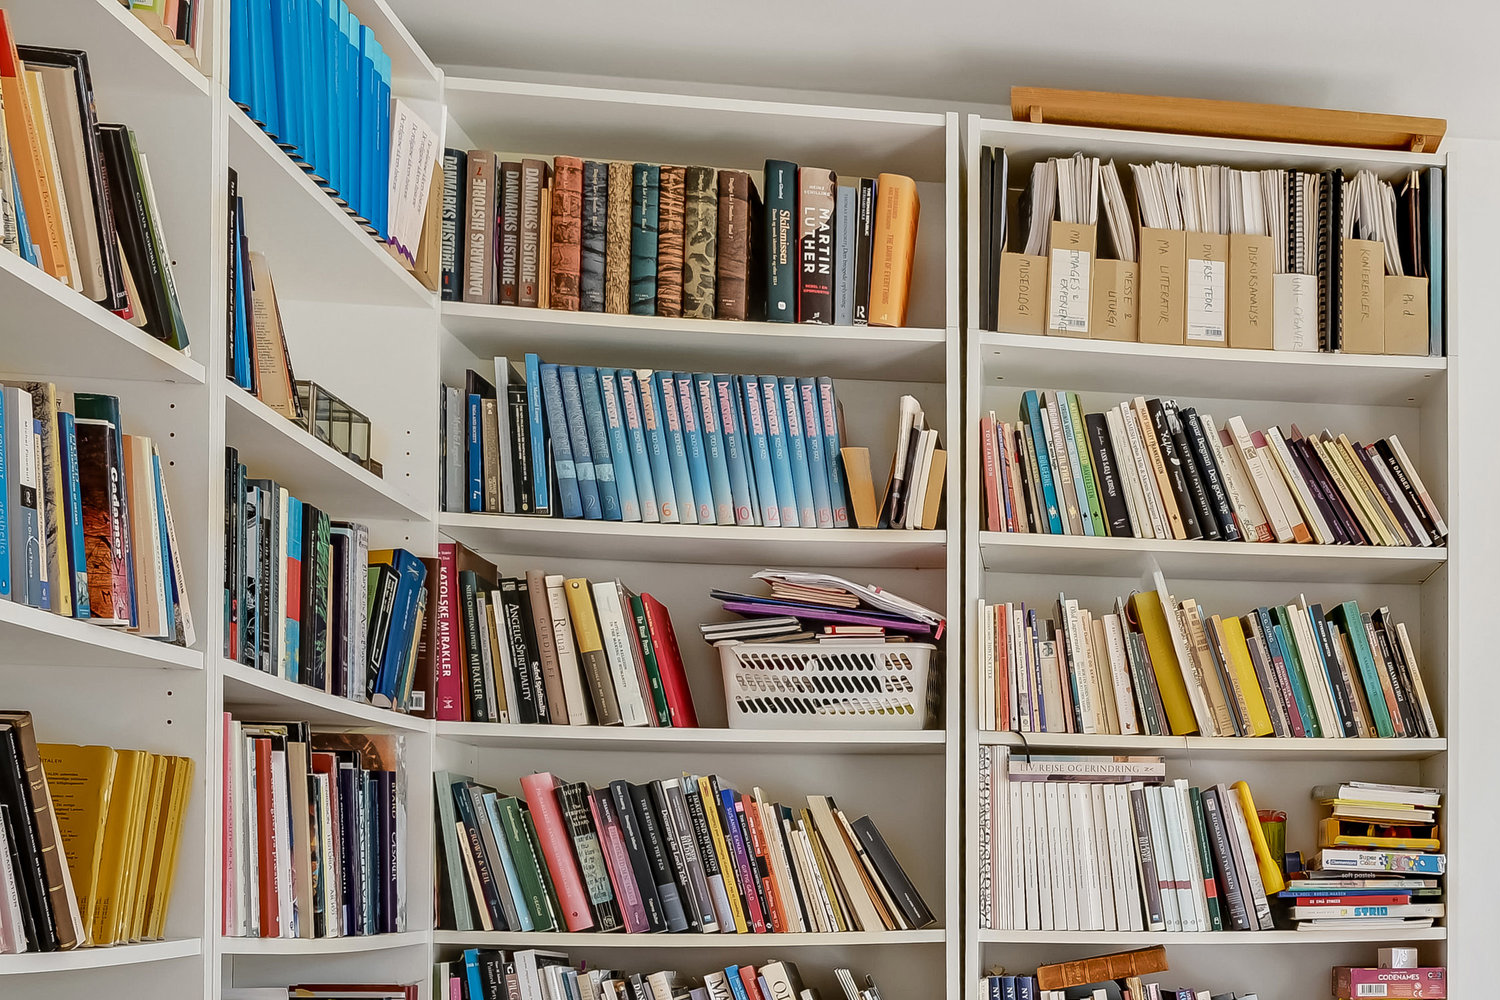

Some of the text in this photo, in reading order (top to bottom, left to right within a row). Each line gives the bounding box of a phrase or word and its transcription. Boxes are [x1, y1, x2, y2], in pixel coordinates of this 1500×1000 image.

[443, 156, 457, 218] DANMARKS
[471, 178, 487, 231] HISTORIE
[523, 168, 539, 229] DANMARKS
[442, 221, 455, 272] HISTORIE
[502, 171, 519, 285] DANMARKS HISTORIE
[779, 210, 790, 265] Skilsmissen
[804, 207, 816, 273] LUTHER
[819, 208, 831, 275] MARTIN
[469, 234, 484, 296] DANMARKS
[522, 232, 536, 283] HISTORIE
[1203, 244, 1214, 313] DIVERSE TEORI
[1124, 271, 1134, 306] MESSE
[1048, 402, 1060, 430] VIRGINIA
[1053, 431, 1065, 454] WOOLF
[111, 467, 122, 560] Gadamer
[439, 567, 451, 677] KATOLSKE MIRAKLER
[553, 617, 569, 655] Ritual
[471, 654, 483, 701] MIRAKLER
[508, 603, 531, 701] ANGELIC SPIRITUALITY
[1085, 763, 1140, 773] ERINDRING
[469, 828, 482, 859] CROWN
[661, 809, 677, 840] Decorating
[701, 833, 716, 872] DEVOTION
